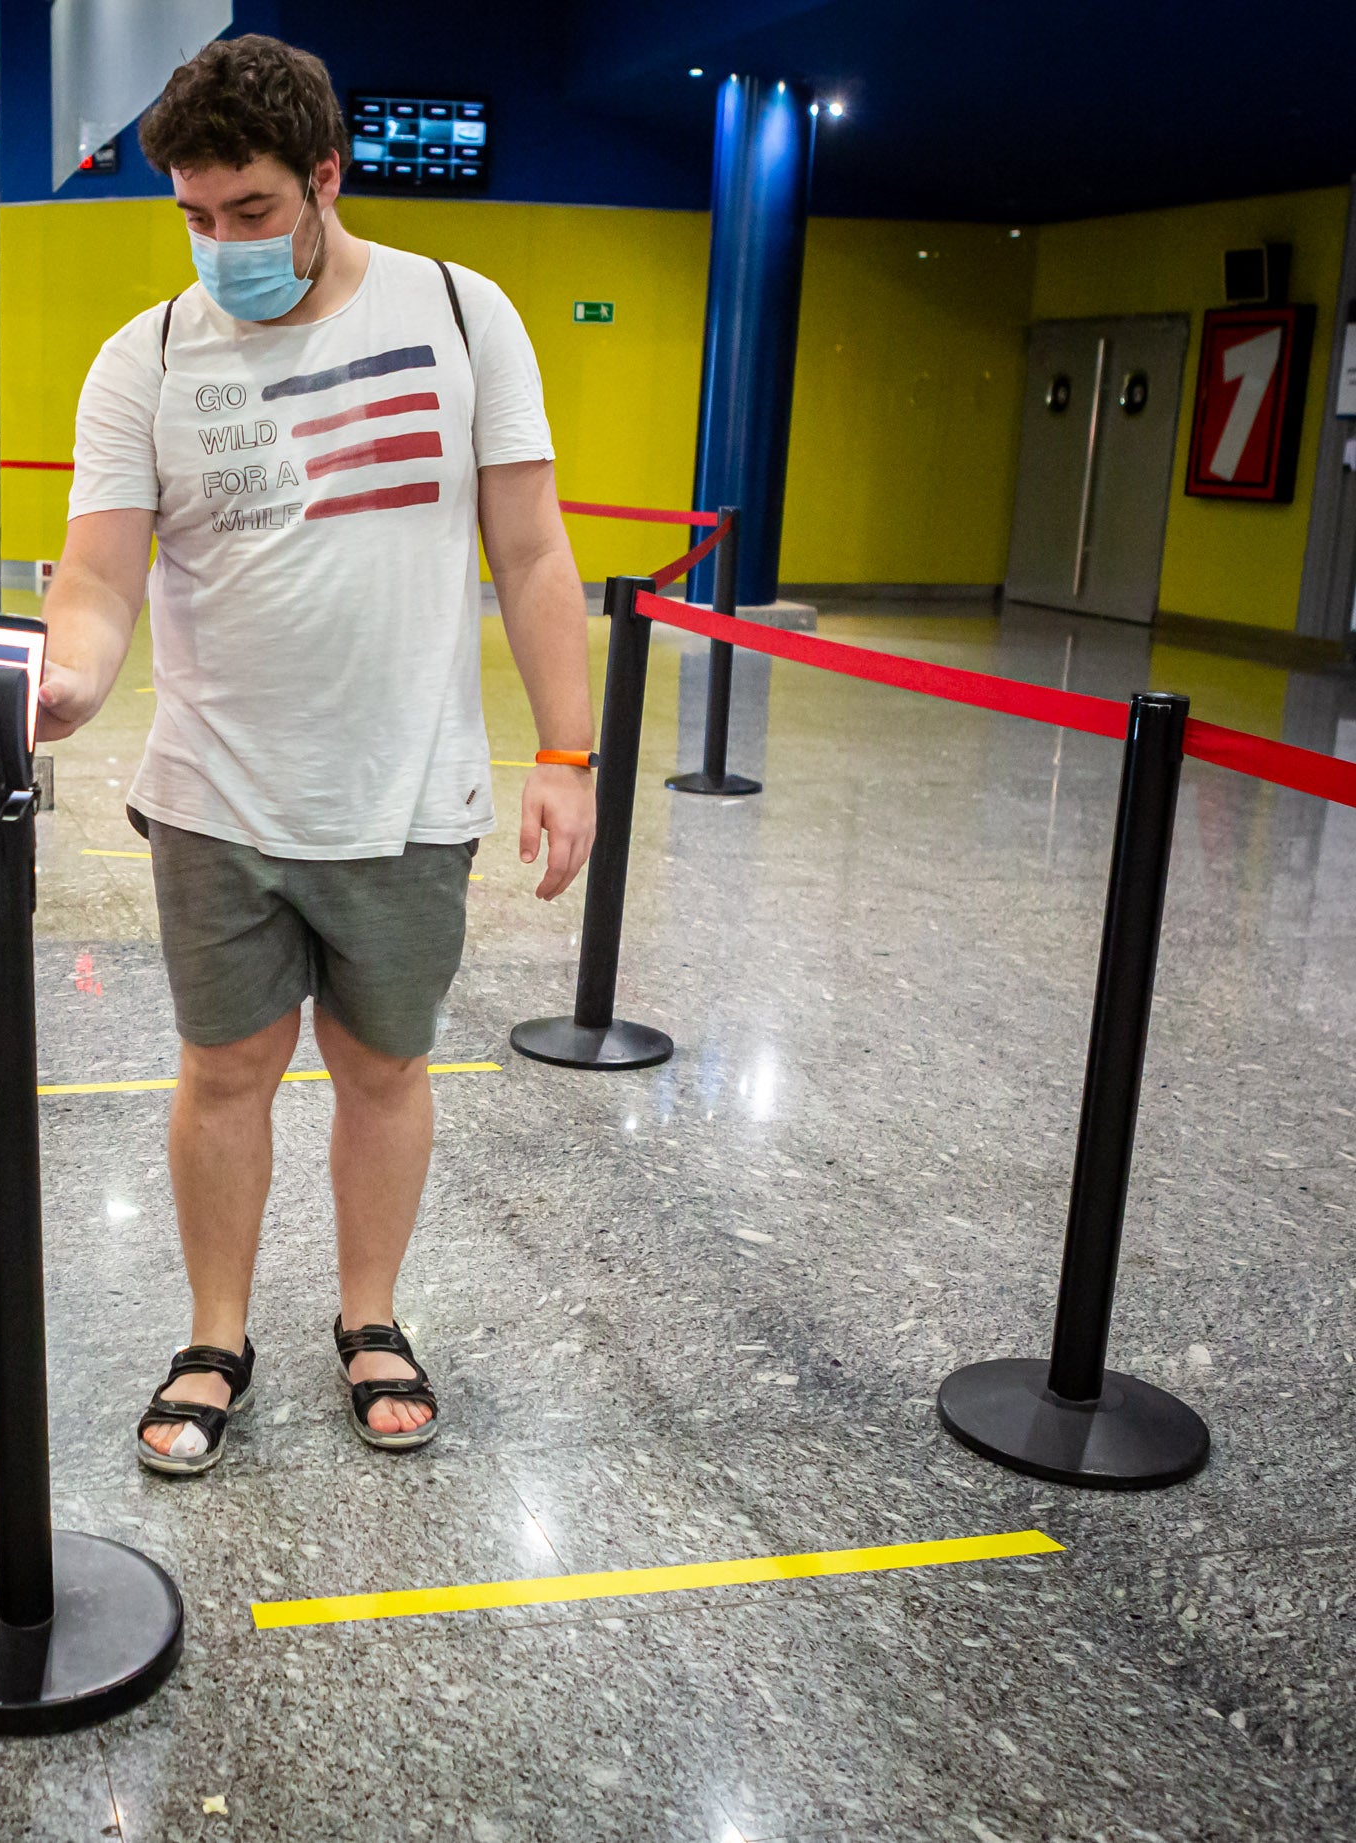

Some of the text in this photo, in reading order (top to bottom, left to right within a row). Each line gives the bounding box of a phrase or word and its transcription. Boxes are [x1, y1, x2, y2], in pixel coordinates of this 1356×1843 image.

[196, 383, 247, 413] GO
[198, 419, 278, 455] WILD
[202, 460, 300, 499] FOR A
[211, 502, 303, 533] WHILE
